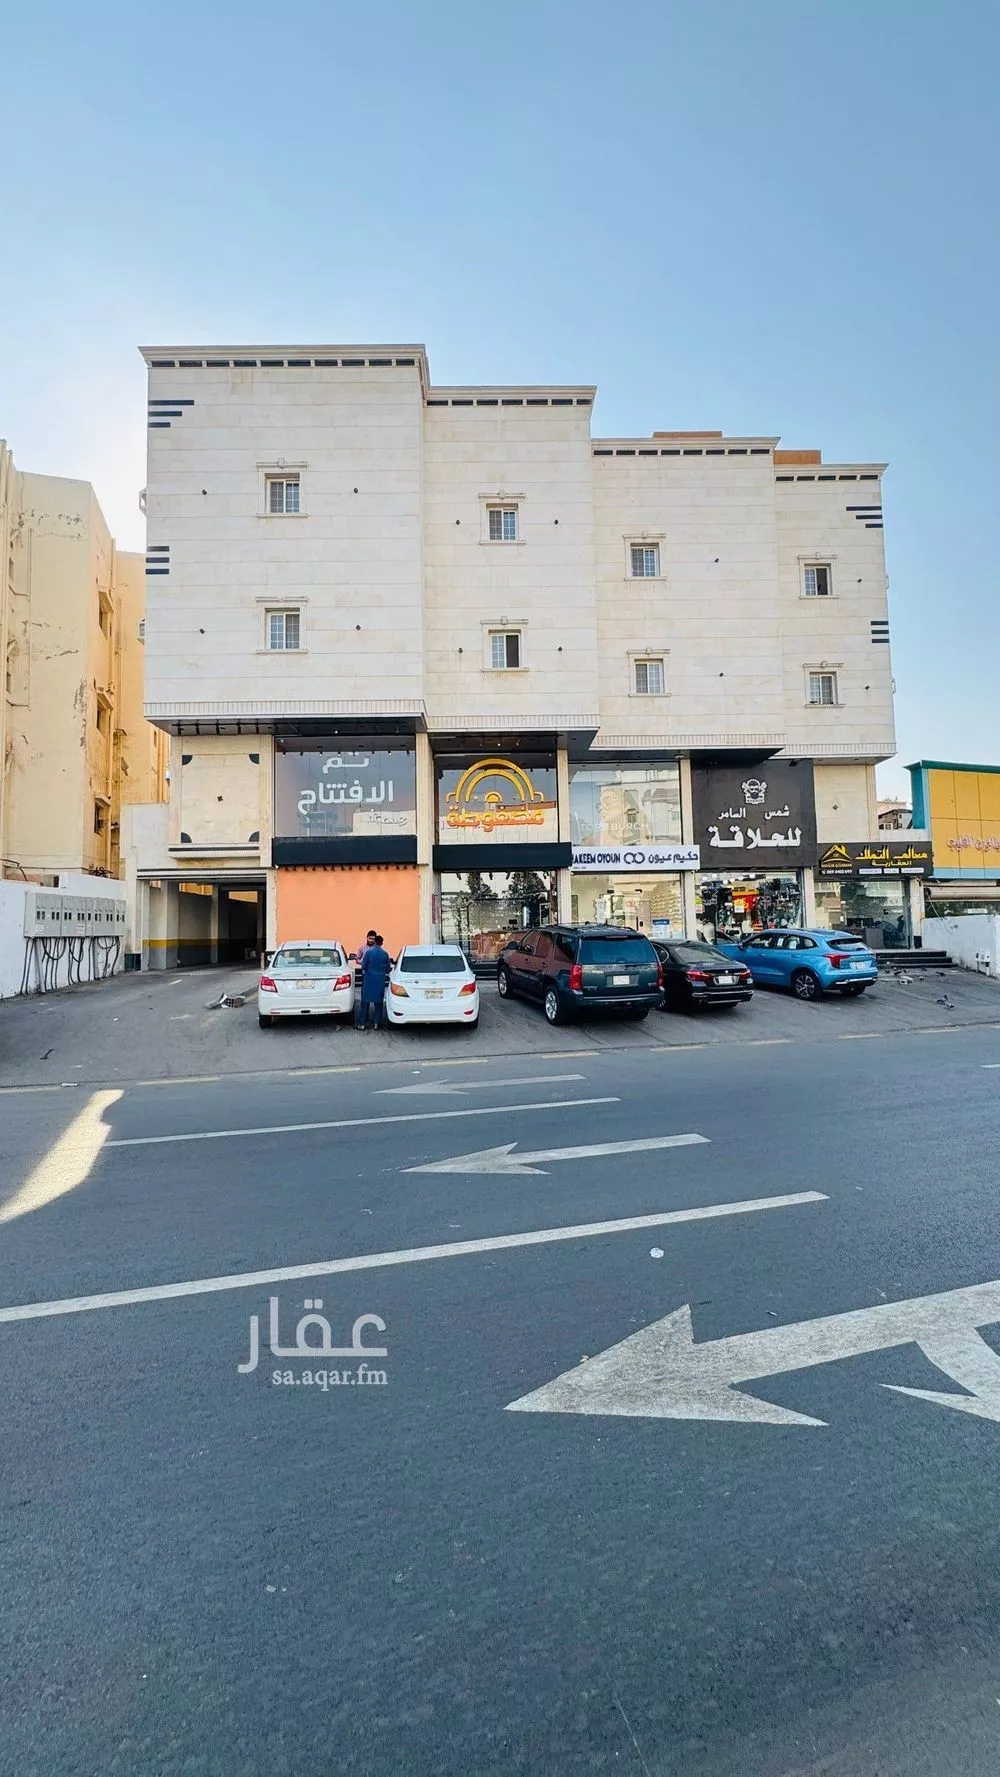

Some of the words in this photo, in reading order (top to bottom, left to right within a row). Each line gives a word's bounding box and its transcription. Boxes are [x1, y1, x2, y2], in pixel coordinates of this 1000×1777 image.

[322, 752, 370, 774] تم
[297, 779, 394, 816] الافتتاح
[446, 805, 545, 832] مضغوطة
[718, 807, 746, 820] السامر
[764, 805, 790, 820] شمس
[708, 824, 802, 850] للحلاقة
[597, 852, 621, 864] OYOUN
[648, 852, 672, 864] عيون
[672, 850, 699, 864] حكيم
